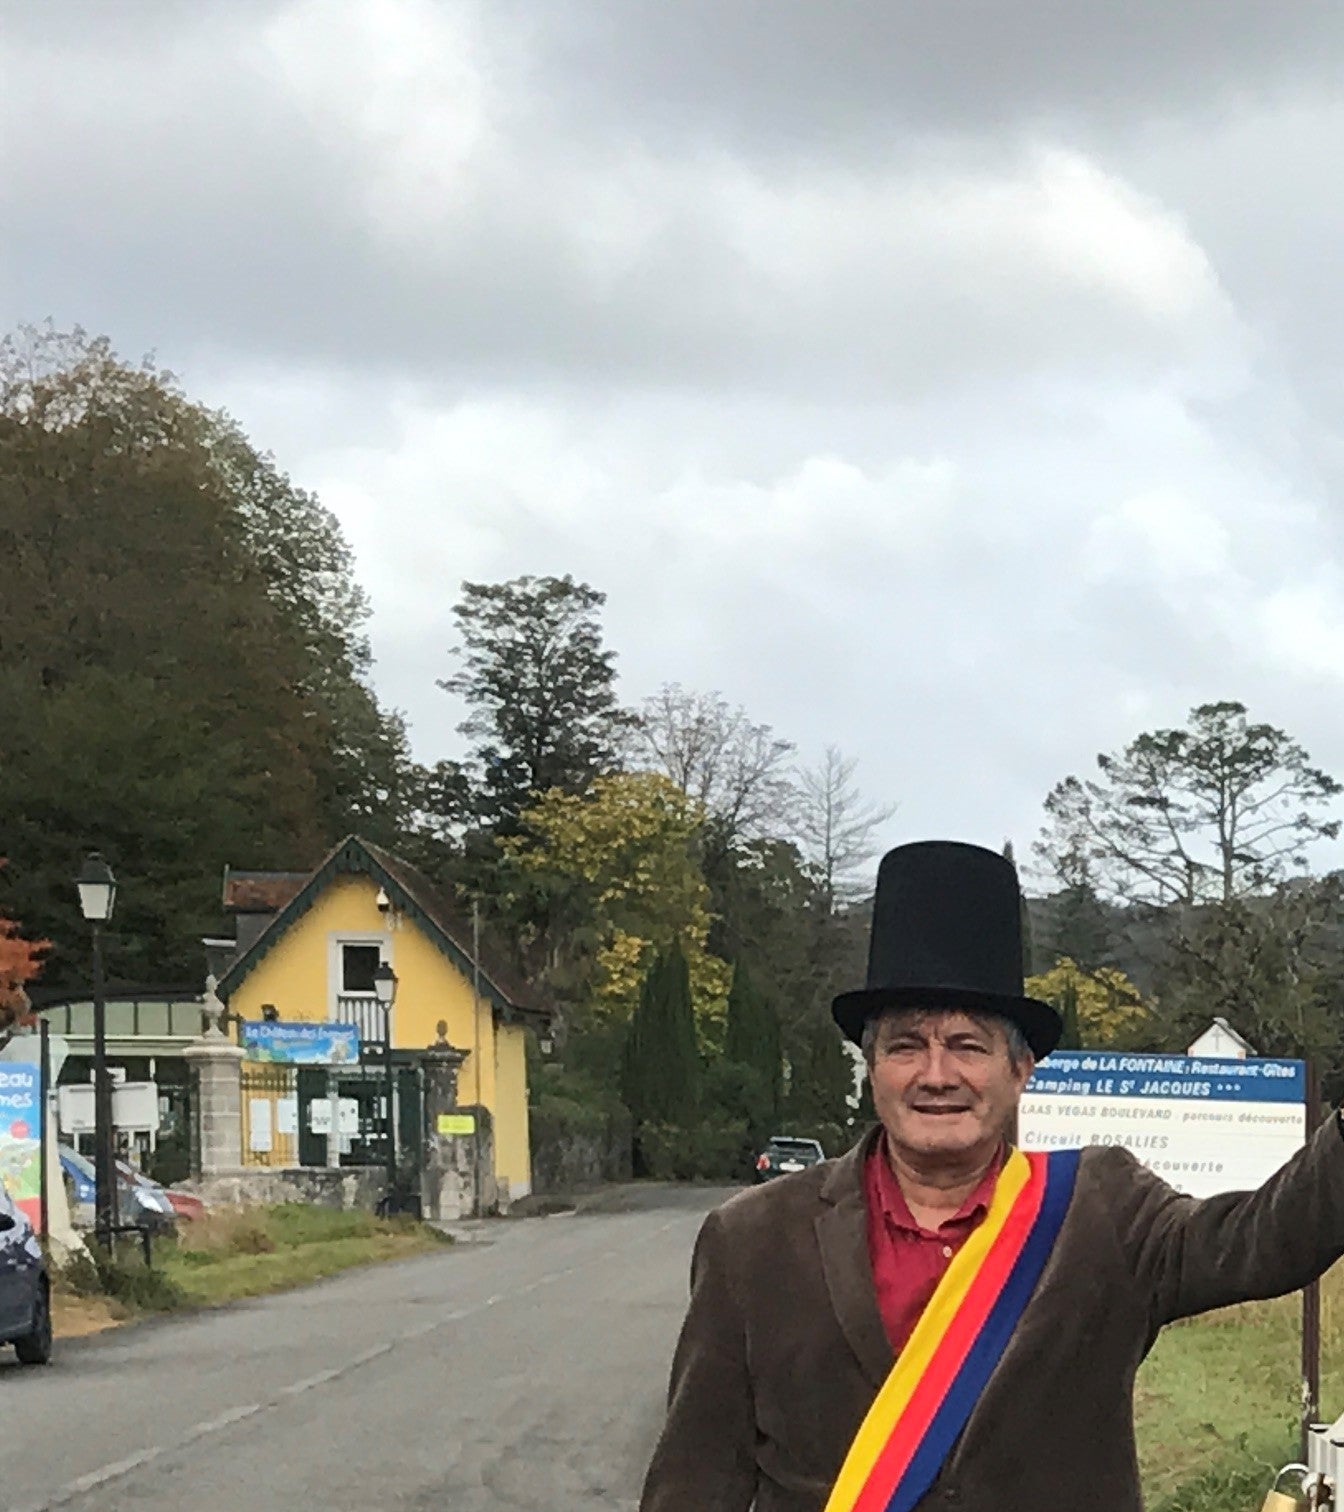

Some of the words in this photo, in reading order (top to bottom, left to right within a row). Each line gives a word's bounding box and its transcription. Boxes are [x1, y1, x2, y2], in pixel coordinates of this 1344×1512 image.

[1098, 1056, 1117, 1072] LA
[1025, 1075, 1091, 1095] Camping
[1096, 1078, 1115, 1094] LE
[1140, 1080, 1212, 1097] JACQUES
[1021, 1103, 1053, 1116] LAAS
[1058, 1105, 1097, 1117] VEGAS
[1101, 1106, 1173, 1121] BOULEVARD
[1182, 1111, 1235, 1124] parcours
[1025, 1130, 1083, 1146] Circuit
[1090, 1132, 1170, 1150] ROSALIES
[1143, 1156, 1225, 1173] écouverte
